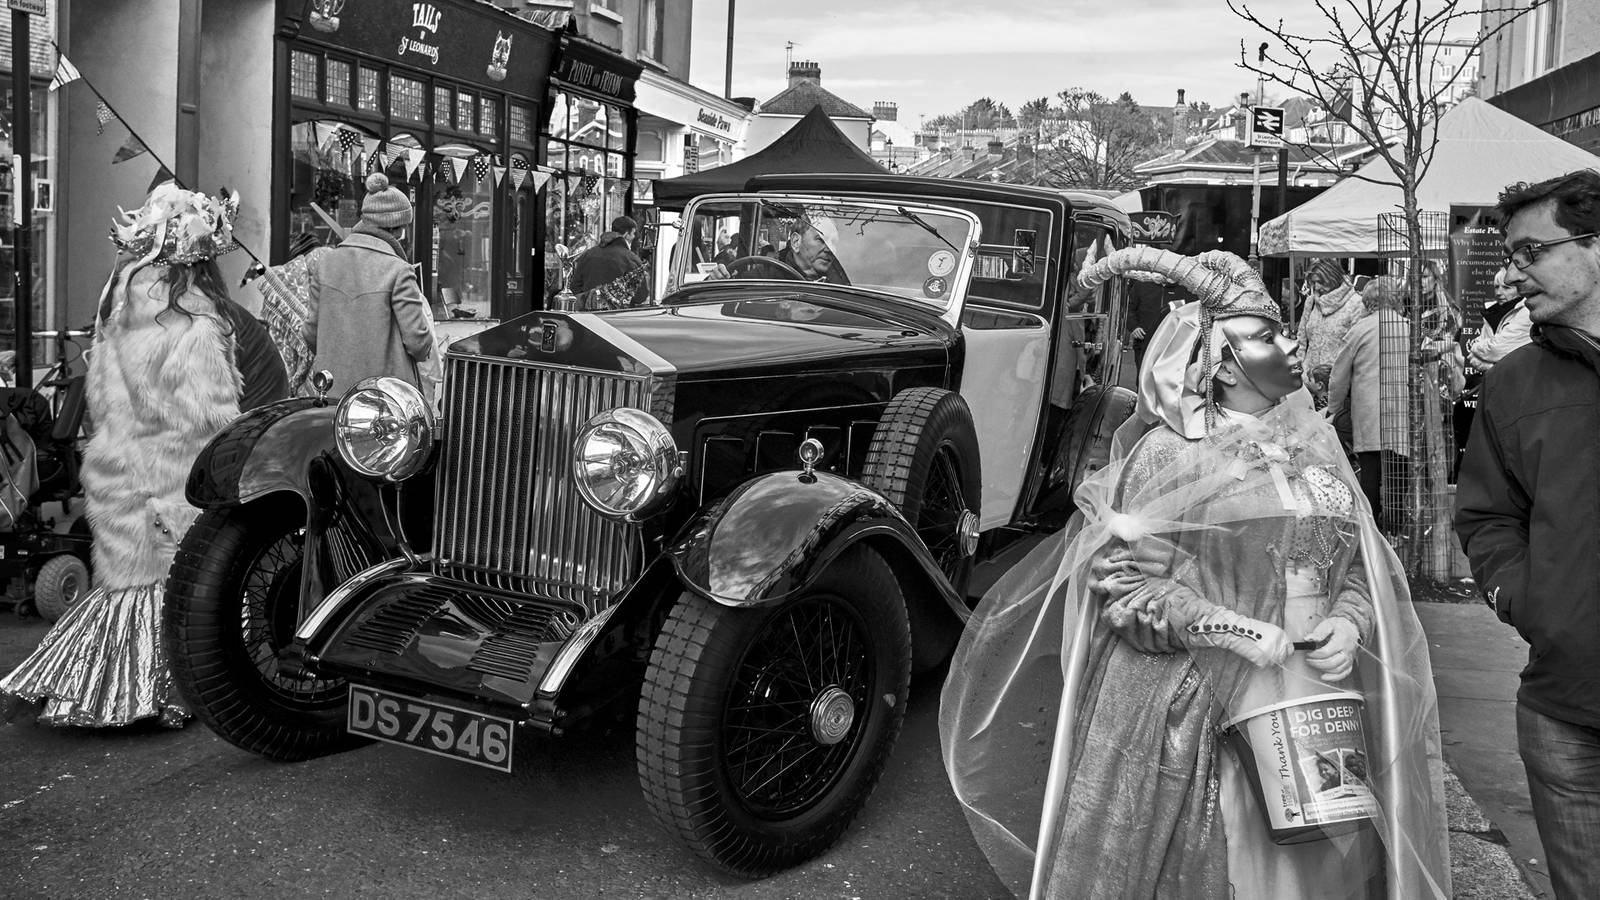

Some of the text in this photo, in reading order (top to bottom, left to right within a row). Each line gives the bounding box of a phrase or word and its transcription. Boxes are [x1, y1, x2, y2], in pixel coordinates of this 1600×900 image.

[412, 3, 442, 34] TAILS
[409, 40, 440, 65] LEONARDS
[717, 115, 731, 132] Paws
[1464, 226, 1501, 234] Estate Pla
[1453, 239, 1470, 247] Why
[1467, 248, 1500, 256] Insurance
[1456, 258, 1503, 266] circumstances
[1461, 327, 1473, 335] EE
[1294, 705, 1354, 723] DIG DEEP
[352, 690, 508, 763] DS 7546
[1290, 719, 1360, 738] FOR DENNY
[1270, 711, 1290, 780] Thank You
